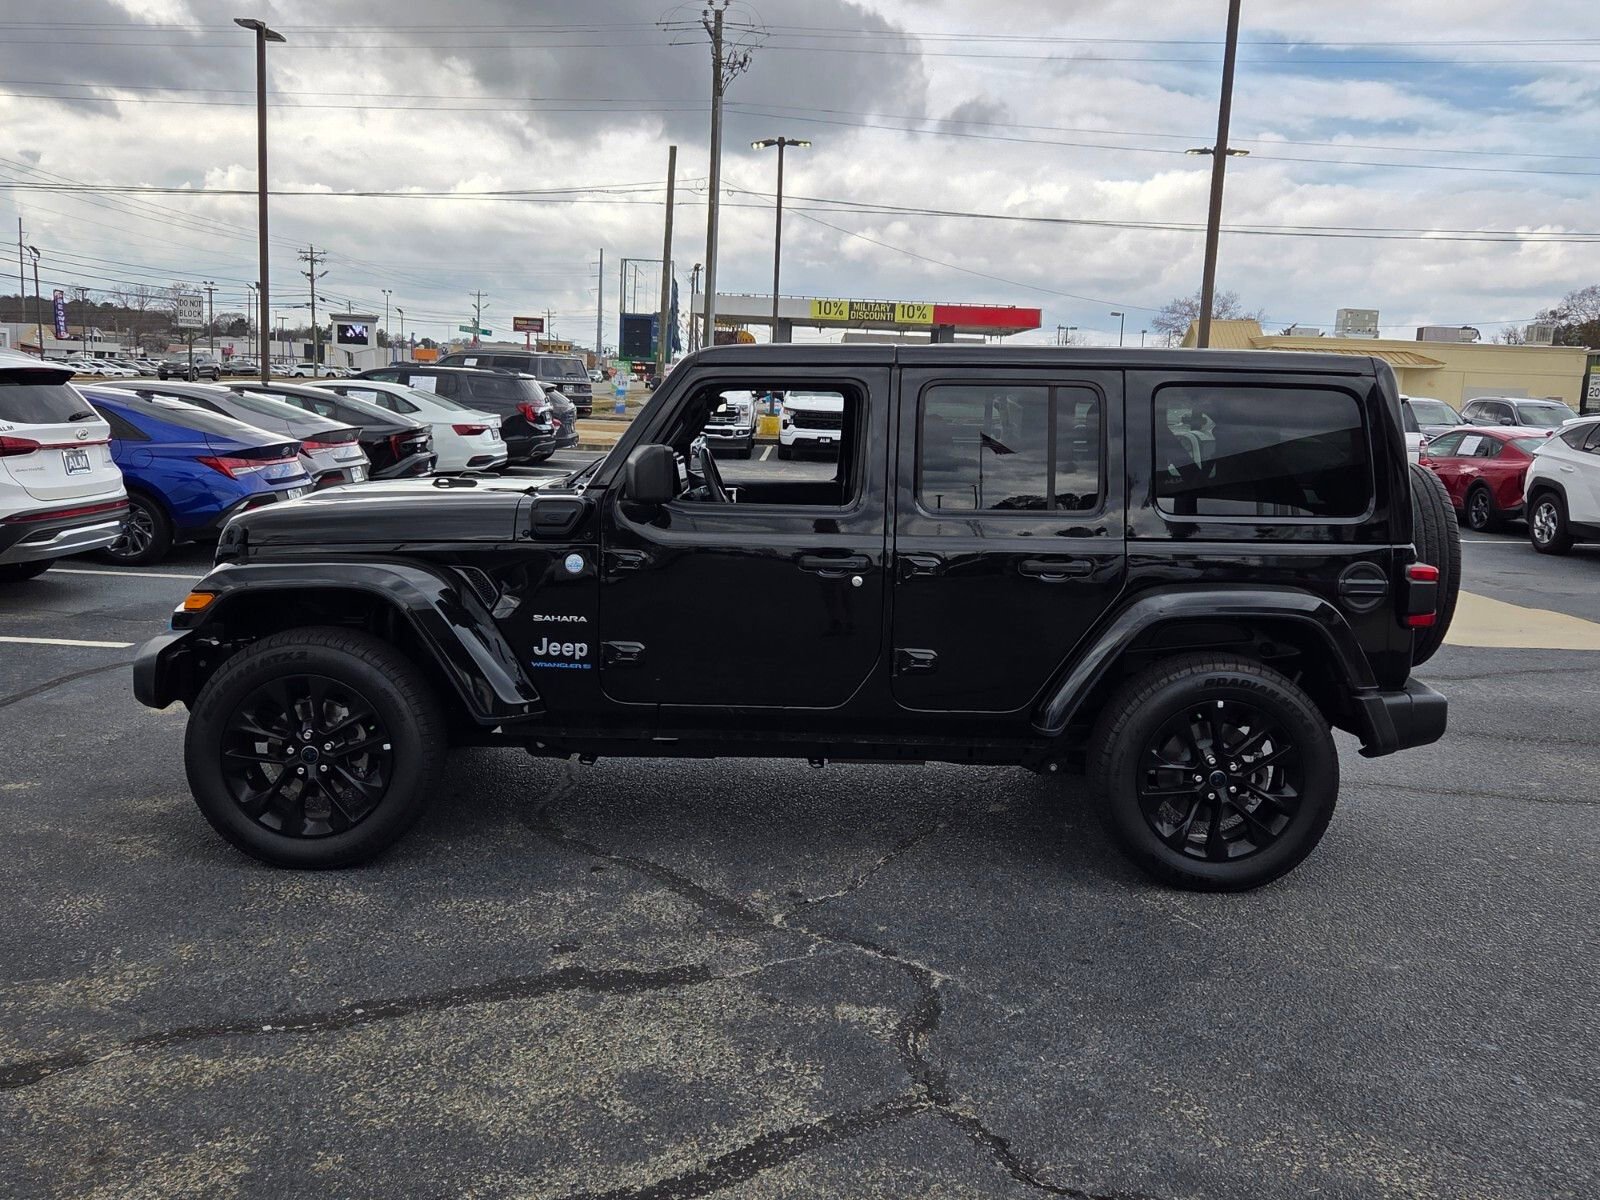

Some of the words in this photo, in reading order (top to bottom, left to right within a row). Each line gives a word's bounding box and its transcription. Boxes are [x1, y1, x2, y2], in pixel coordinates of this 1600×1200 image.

[179, 299, 188, 307] DO
[190, 300, 201, 308] NOT
[817, 300, 844, 316] 10%
[853, 303, 891, 311] MILITARY
[179, 309, 202, 317] BLOCK
[850, 311, 893, 320] DISCOUNT!
[900, 304, 927, 319] 10%
[68, 455, 89, 469] ALM
[532, 614, 588, 623] SAHARA
[533, 637, 588, 660] Jeep
